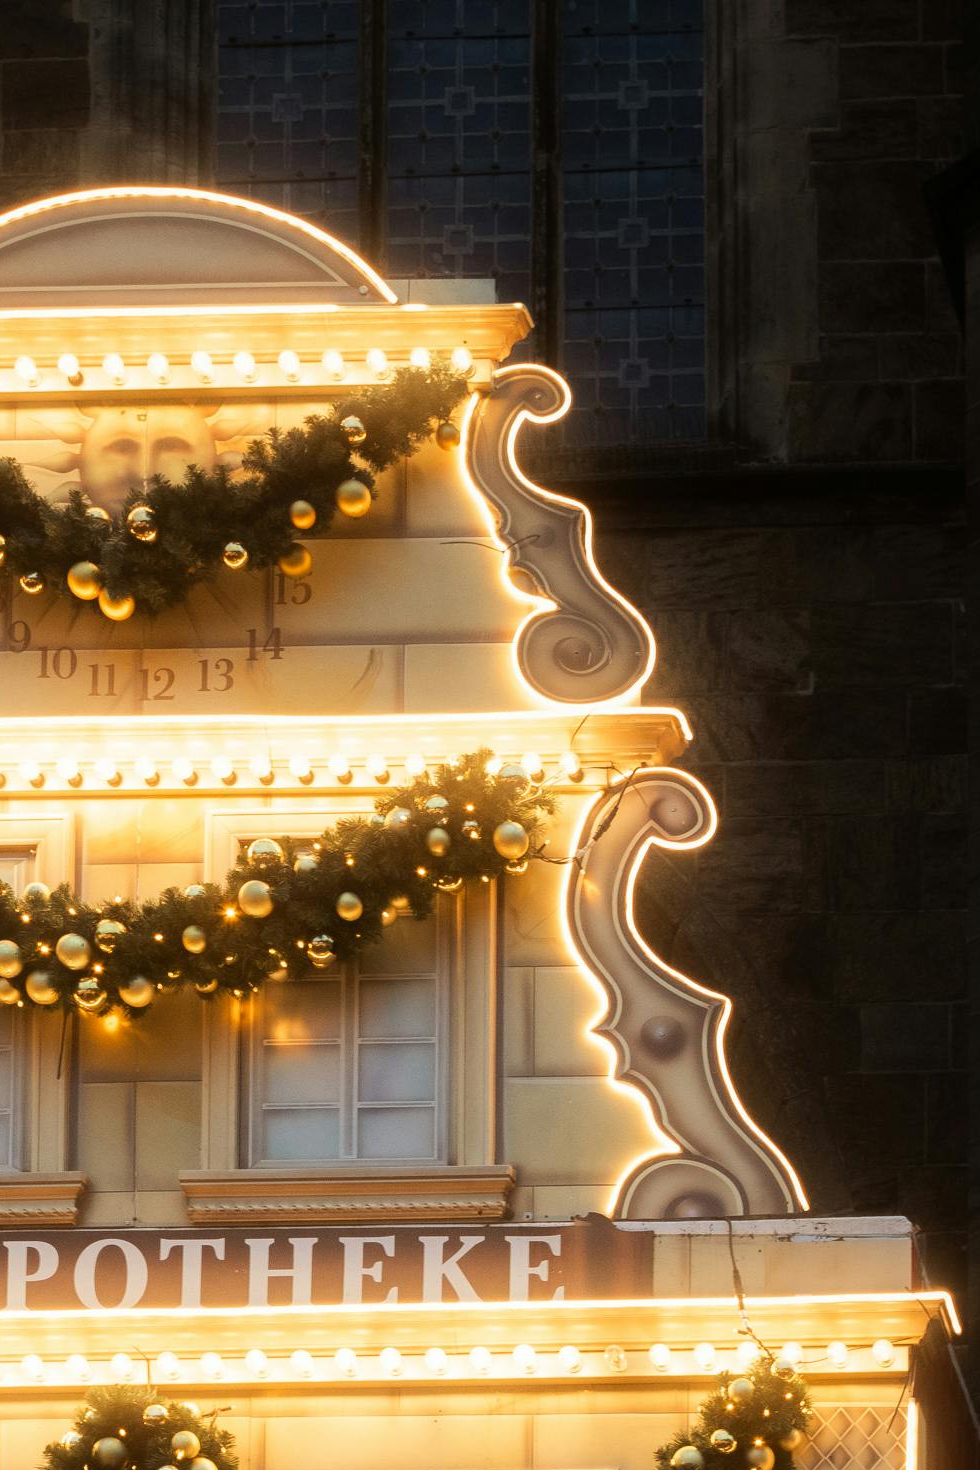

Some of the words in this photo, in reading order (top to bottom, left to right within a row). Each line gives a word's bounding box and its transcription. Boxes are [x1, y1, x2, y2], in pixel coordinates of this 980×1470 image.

[274, 572, 312, 606] 15
[8, 620, 32, 654] 9
[244, 627, 285, 662] 14
[37, 645, 78, 680] 10
[198, 658, 235, 692] 13
[88, 663, 118, 697] 11
[139, 666, 177, 701] 12
